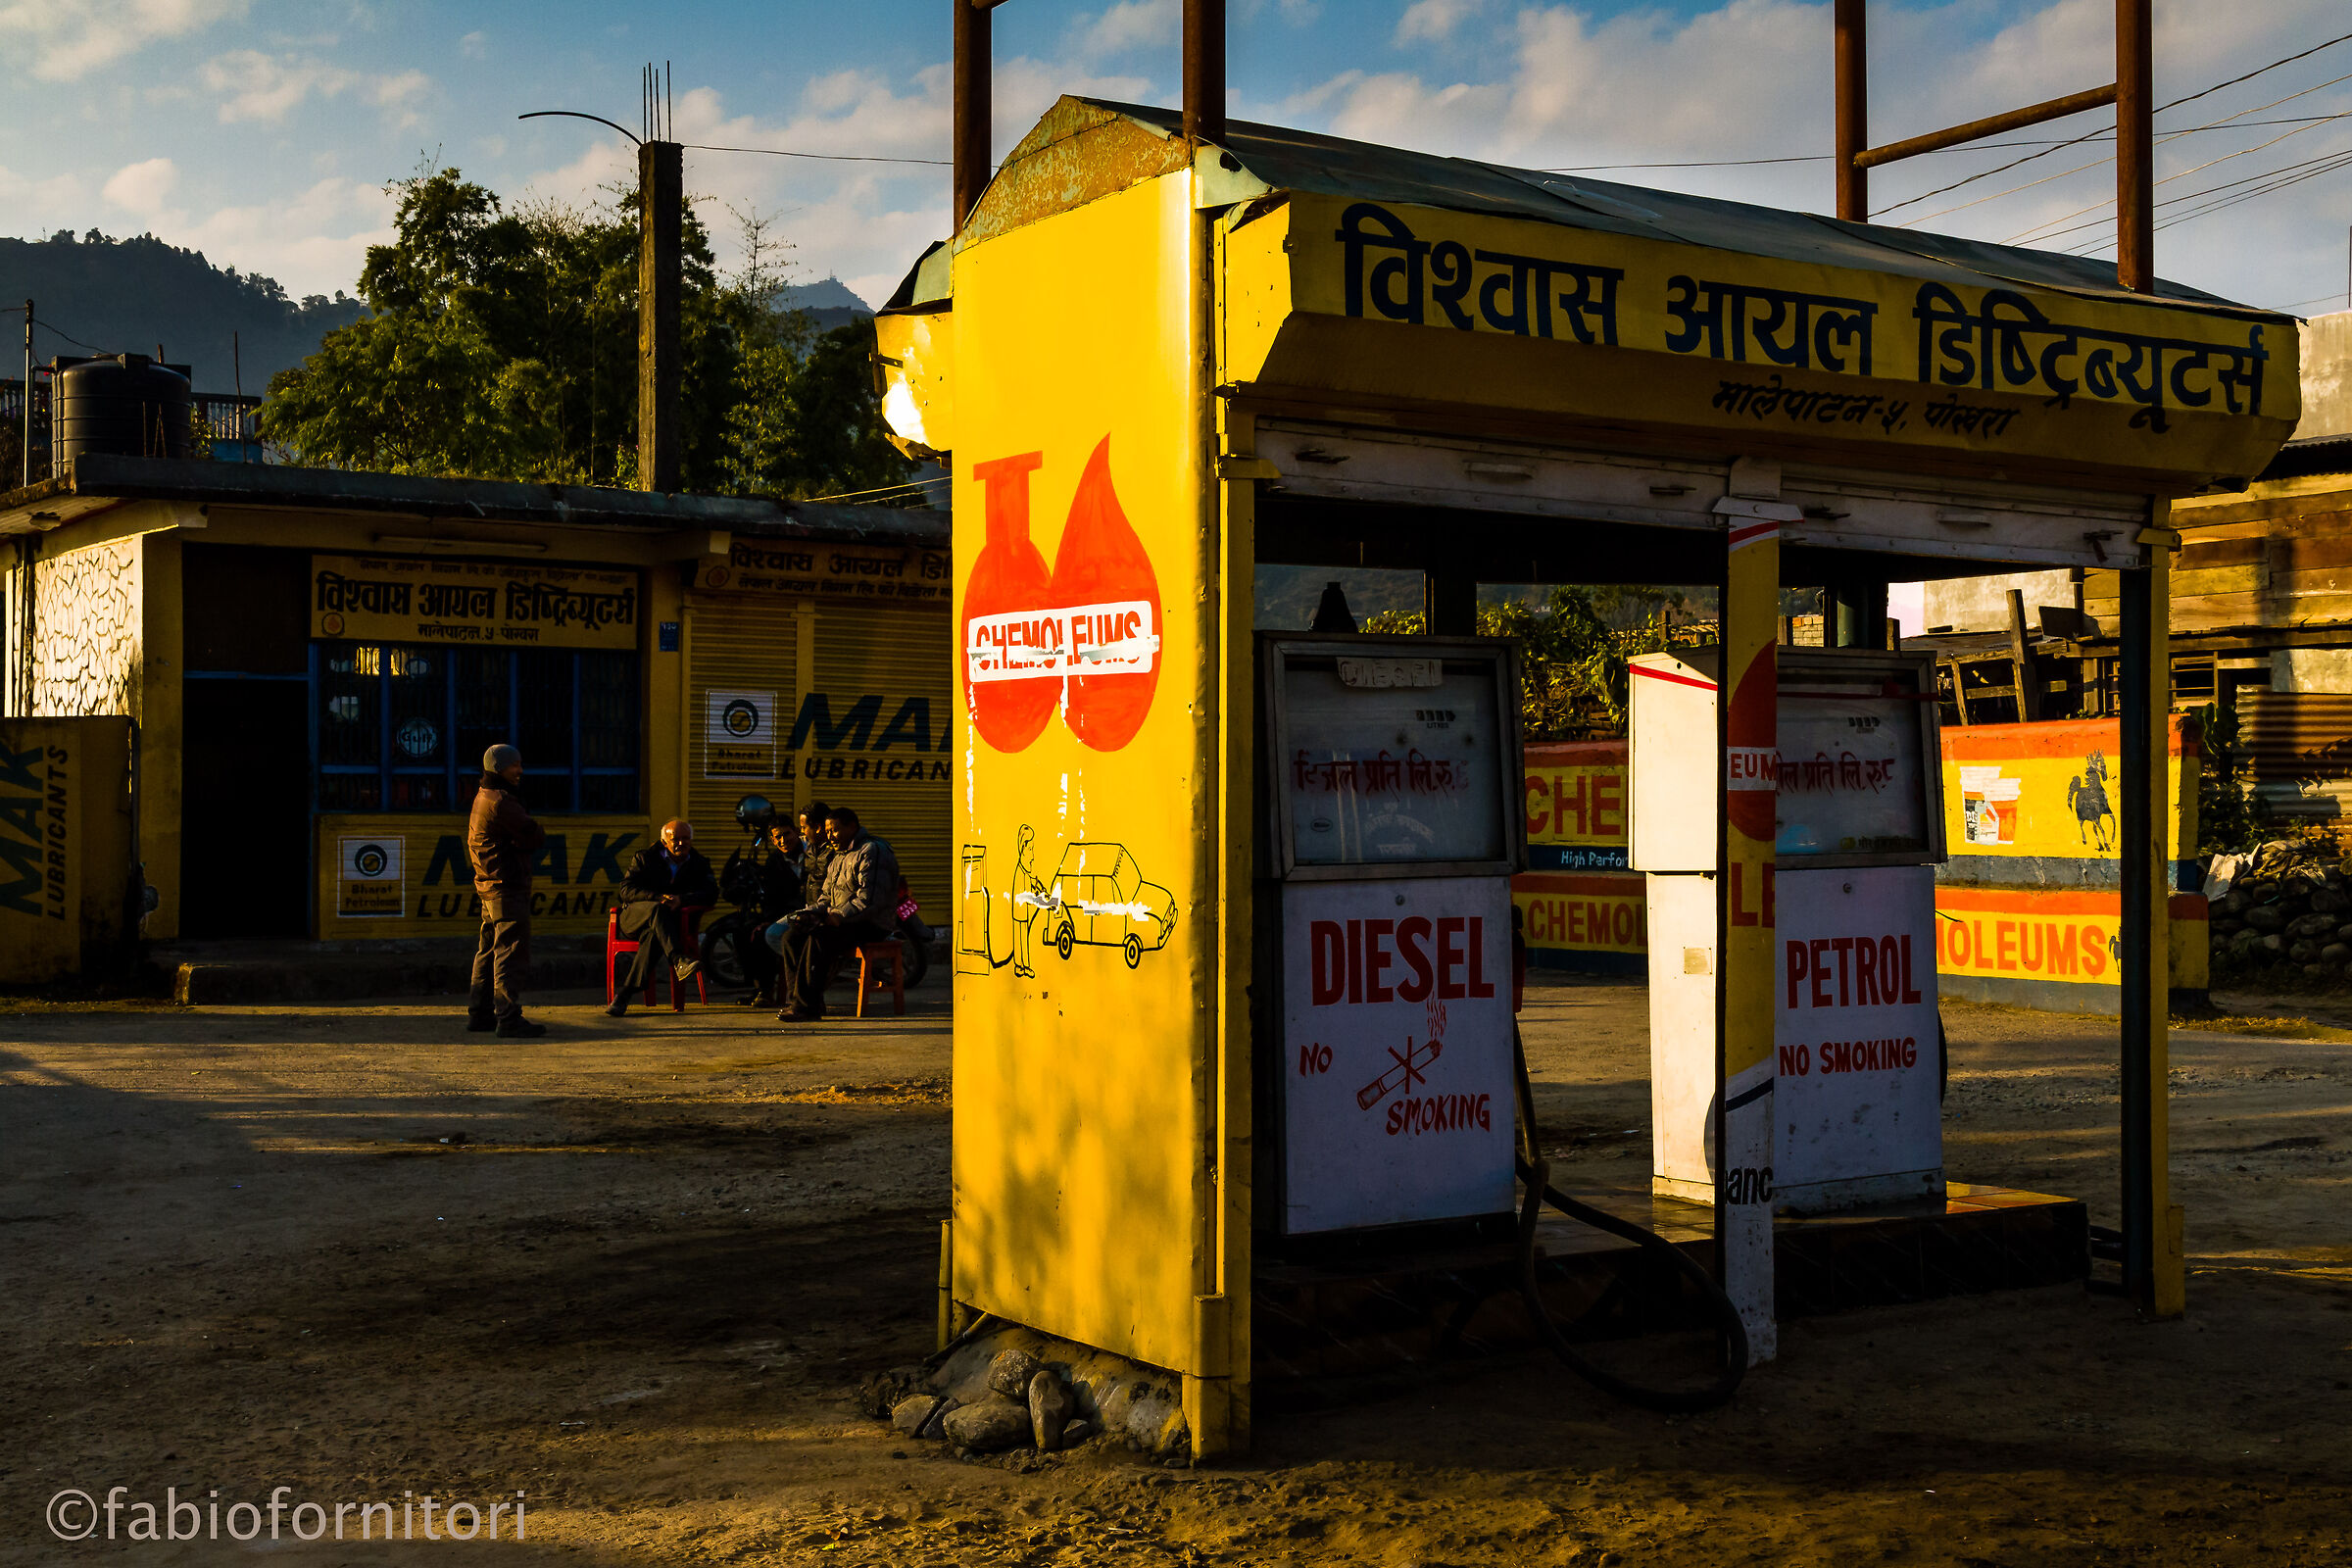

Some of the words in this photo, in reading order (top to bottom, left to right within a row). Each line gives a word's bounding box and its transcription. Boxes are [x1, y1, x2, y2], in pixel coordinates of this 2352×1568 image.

[1336, 203, 1624, 347] विश्वास
[1665, 275, 1878, 375] आयल
[1924, 394, 2020, 438] पोखरा
[729, 542, 813, 571] विश्वास
[317, 571, 413, 614] विश्वास
[418, 583, 497, 618] आयल
[1526, 776, 1628, 835] CHE
[47, 745, 69, 921] LUBRICANTS
[1561, 851, 1586, 869] High
[1310, 916, 1494, 1005] DIESEL
[1787, 935, 1922, 1008] PETROL
[1299, 1042, 1333, 1077] NO
[1779, 1045, 1810, 1076] NO
[1820, 1037, 1917, 1074] SMOKING
[1386, 1093, 1491, 1136] SMOKING
